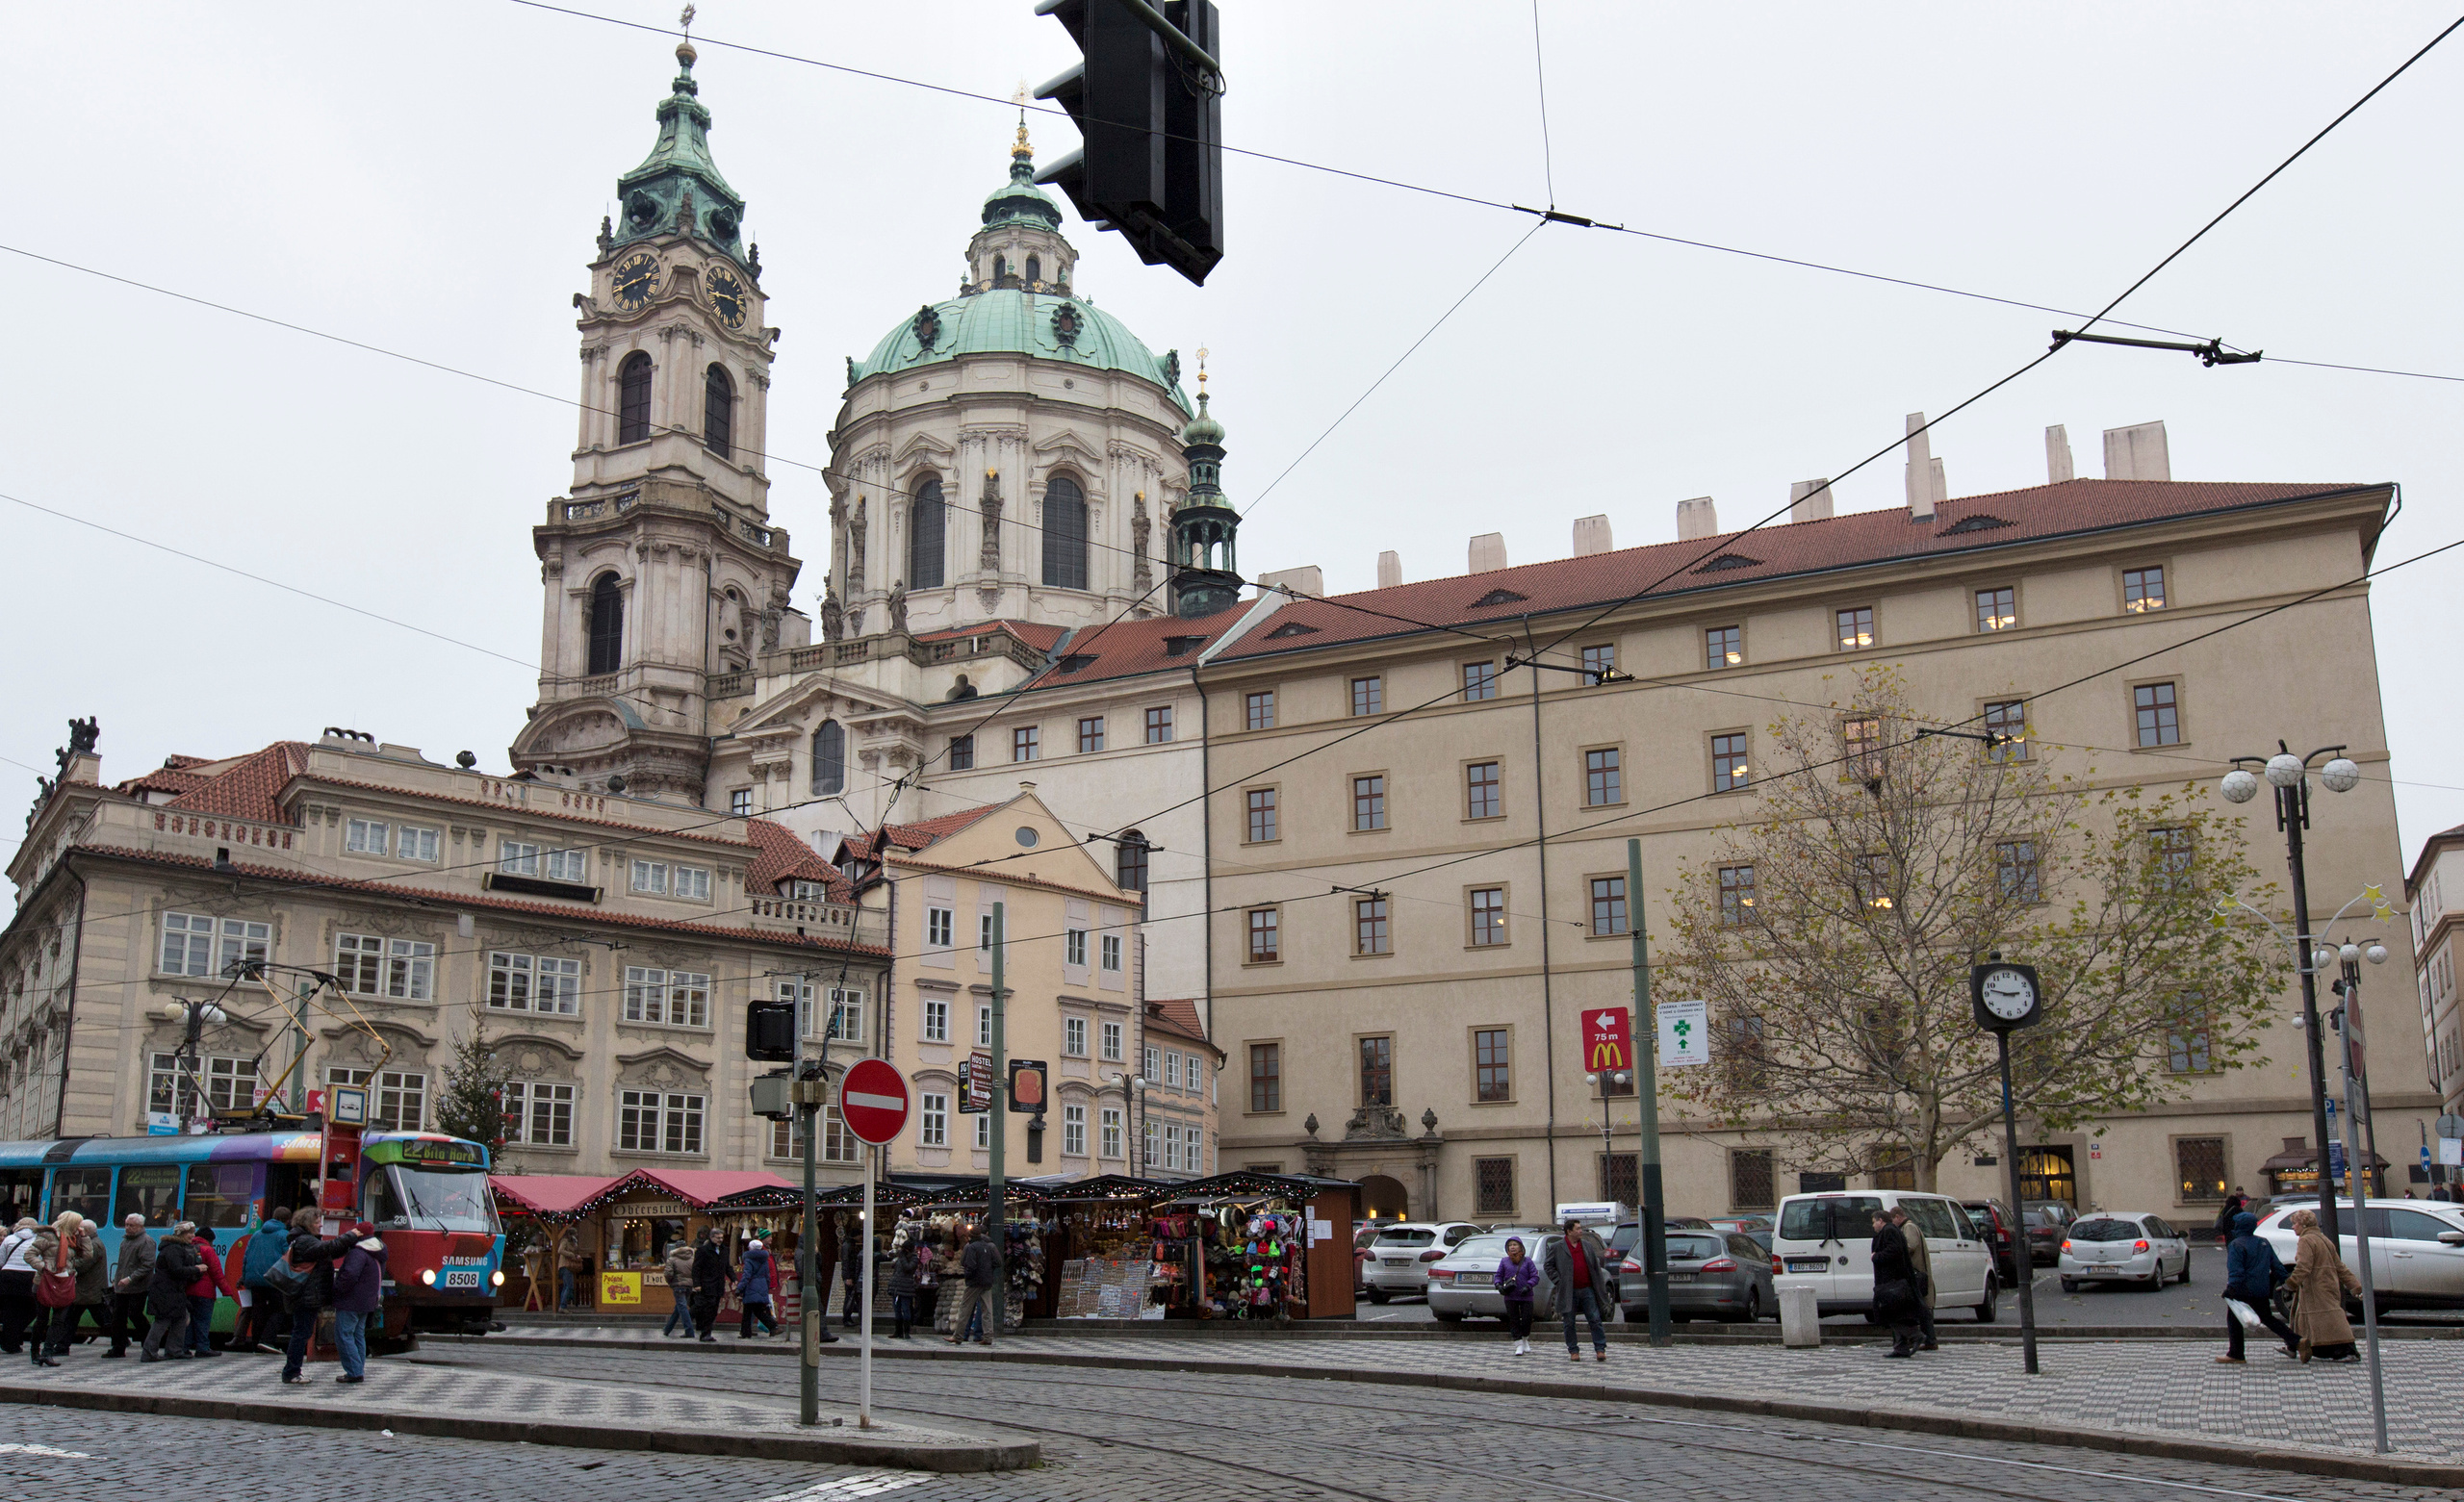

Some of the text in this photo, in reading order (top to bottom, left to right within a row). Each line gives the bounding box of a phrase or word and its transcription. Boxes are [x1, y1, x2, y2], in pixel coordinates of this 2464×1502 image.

[972, 1055, 991, 1066] HOSTEL
[404, 1141, 422, 1158] 22
[442, 1256, 488, 1266] SAMSUNG
[449, 1273, 477, 1286] 8508
